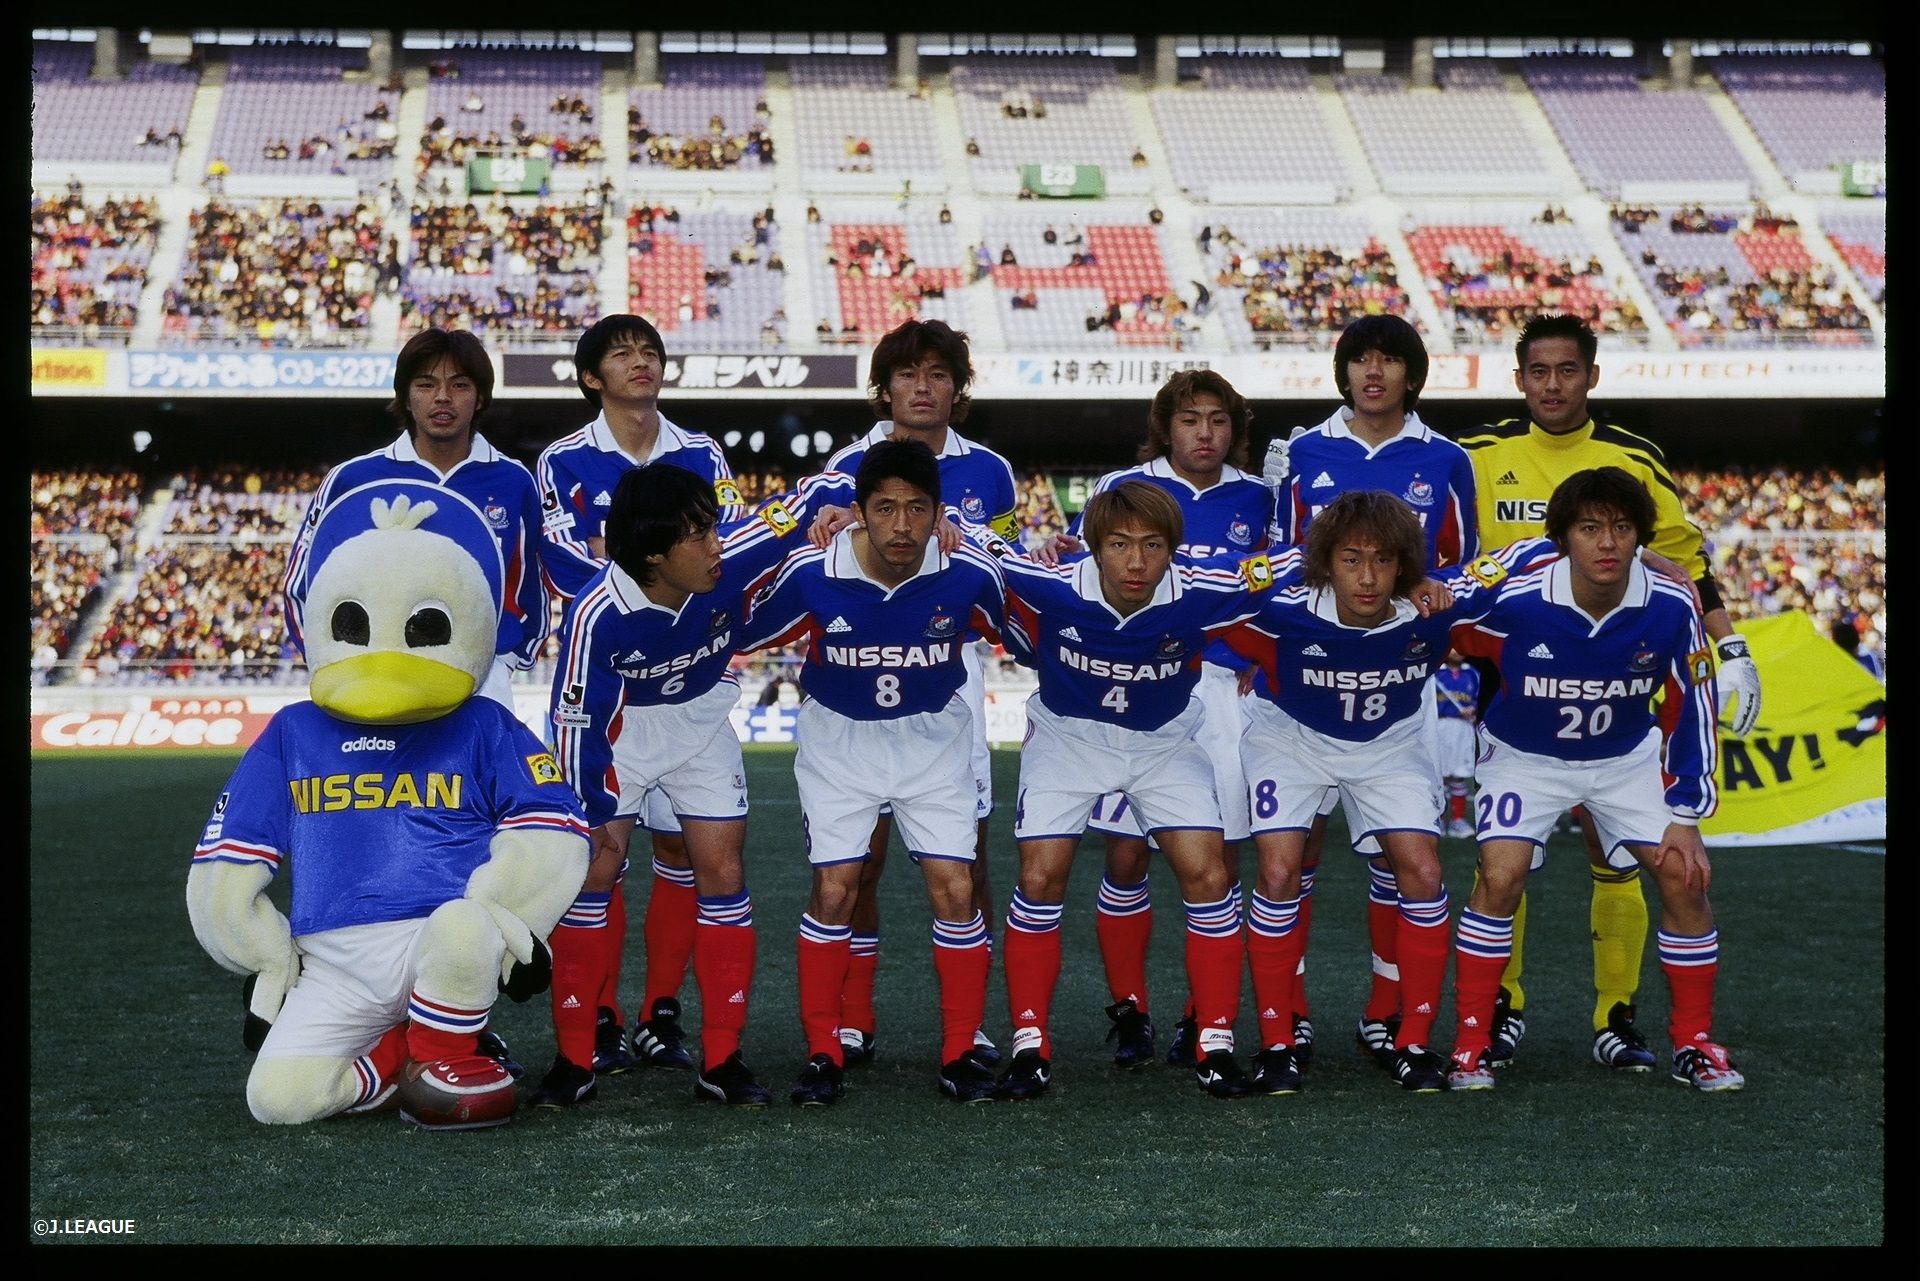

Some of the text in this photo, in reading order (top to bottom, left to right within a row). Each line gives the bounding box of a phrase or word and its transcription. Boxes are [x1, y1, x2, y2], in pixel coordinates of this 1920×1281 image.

[1617, 363, 1770, 380] AUTECH
[826, 625, 852, 633] adidas
[617, 631, 731, 680] NISSAN
[826, 642, 950, 668] NISSAN
[1059, 646, 1182, 682] NISSAN
[661, 672, 686, 696] 6
[875, 673, 901, 708] 8
[1302, 663, 1428, 691] NISSAN
[1523, 675, 1653, 701] NISSAN
[1101, 685, 1129, 714] 4
[1339, 692, 1387, 722] 18
[41, 711, 244, 747] Calbee
[1556, 704, 1613, 740] 20
[341, 737, 396, 753] adidas
[289, 772, 463, 815] NISSAN
[1478, 791, 1523, 833] 20
